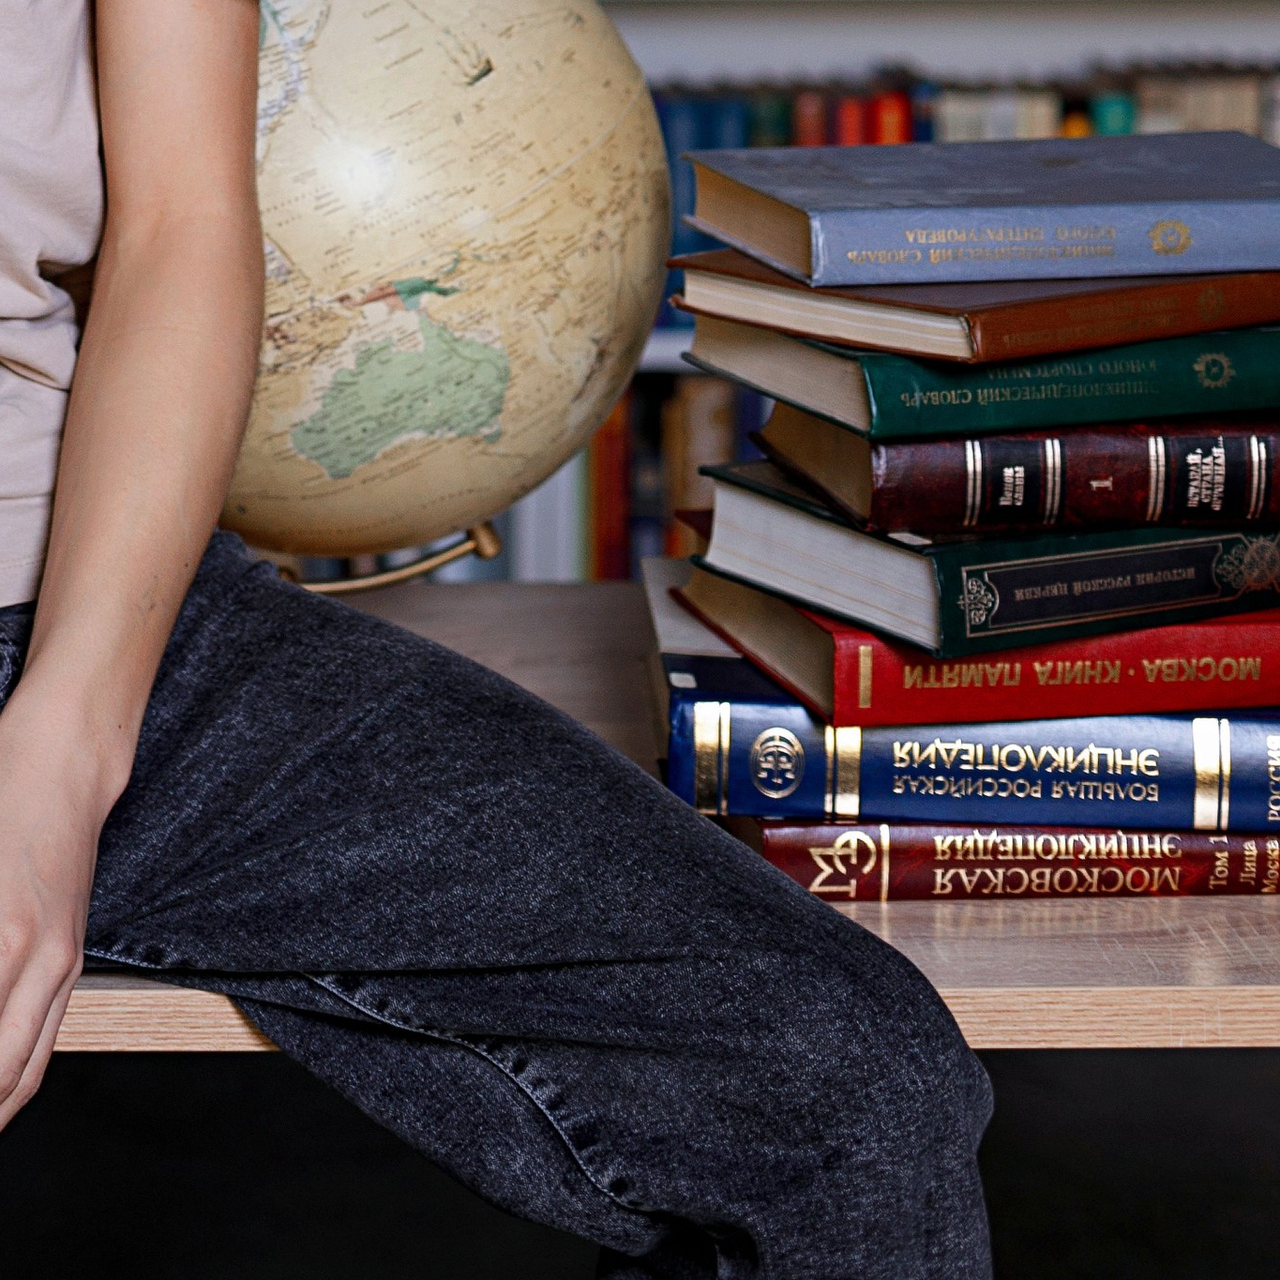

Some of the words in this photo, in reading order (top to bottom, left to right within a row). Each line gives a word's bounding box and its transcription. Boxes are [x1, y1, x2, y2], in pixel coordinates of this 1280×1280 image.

[846, 248, 921, 264] СЛОВАРЬ
[900, 390, 972, 407] СЛОВАРЬ
[1089, 476, 1113, 492] 1
[1201, 455, 1214, 503] СТРАНА
[1073, 575, 1132, 596] РУССКОЙ
[1137, 567, 1196, 587] ИСТОРИЯ
[1015, 582, 1068, 601] ЦЕРКВИ
[903, 663, 1021, 689] ПАМЯТИ
[1033, 660, 1121, 685] КНИГА
[1141, 656, 1261, 682] МОСКВА
[893, 738, 1160, 777] ЭНЦИКЛОПЕДИЯ
[893, 775, 1042, 799] РОССИЙСКАЯ
[1051, 780, 1159, 802] БОЛЬШАЯ
[932, 829, 1183, 861] ЭНЦИКЛОПЕДИЯ
[1209, 835, 1228, 844] 1
[1209, 851, 1229, 889] Том
[1240, 840, 1258, 886] Лица
[931, 866, 1182, 895] МОСКОВСКАЯ
